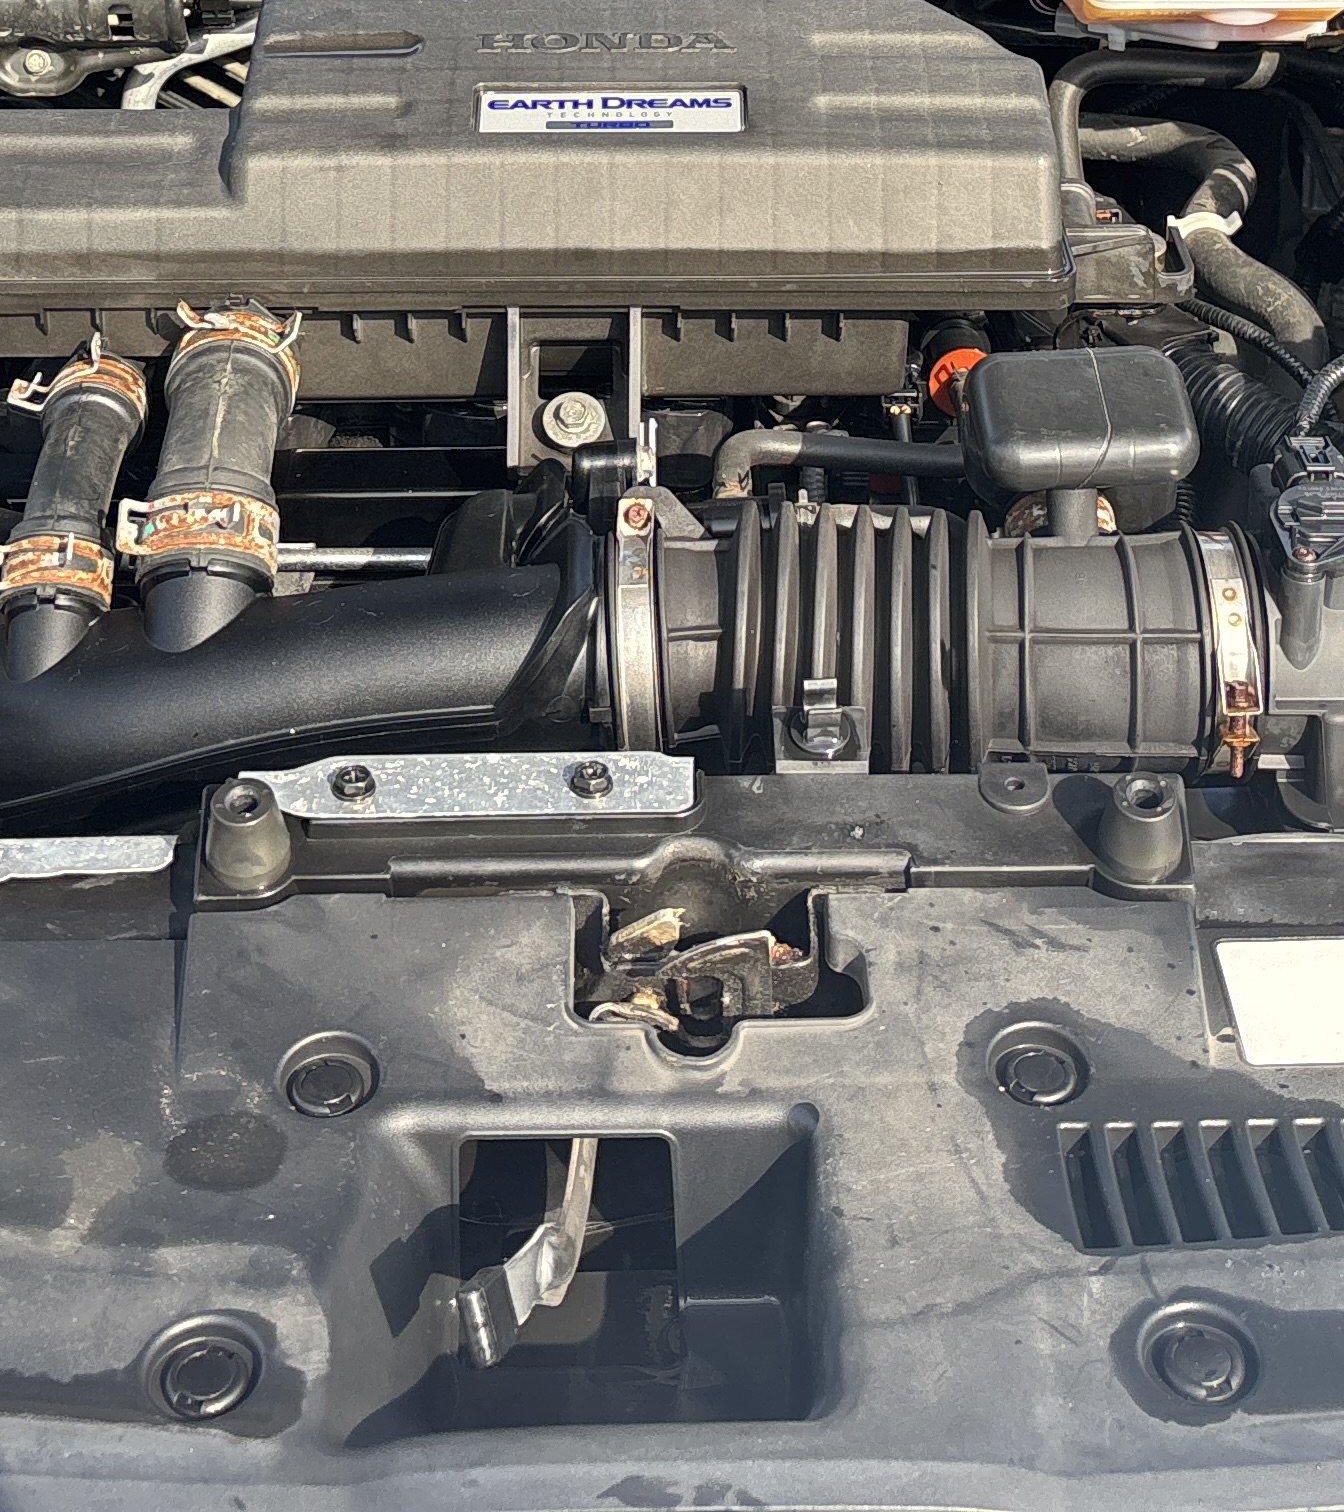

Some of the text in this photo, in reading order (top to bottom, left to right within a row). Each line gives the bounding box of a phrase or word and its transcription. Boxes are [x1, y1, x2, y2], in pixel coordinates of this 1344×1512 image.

[476, 32, 738, 54] HONDA
[487, 96, 733, 110] EARTH DREAMS
